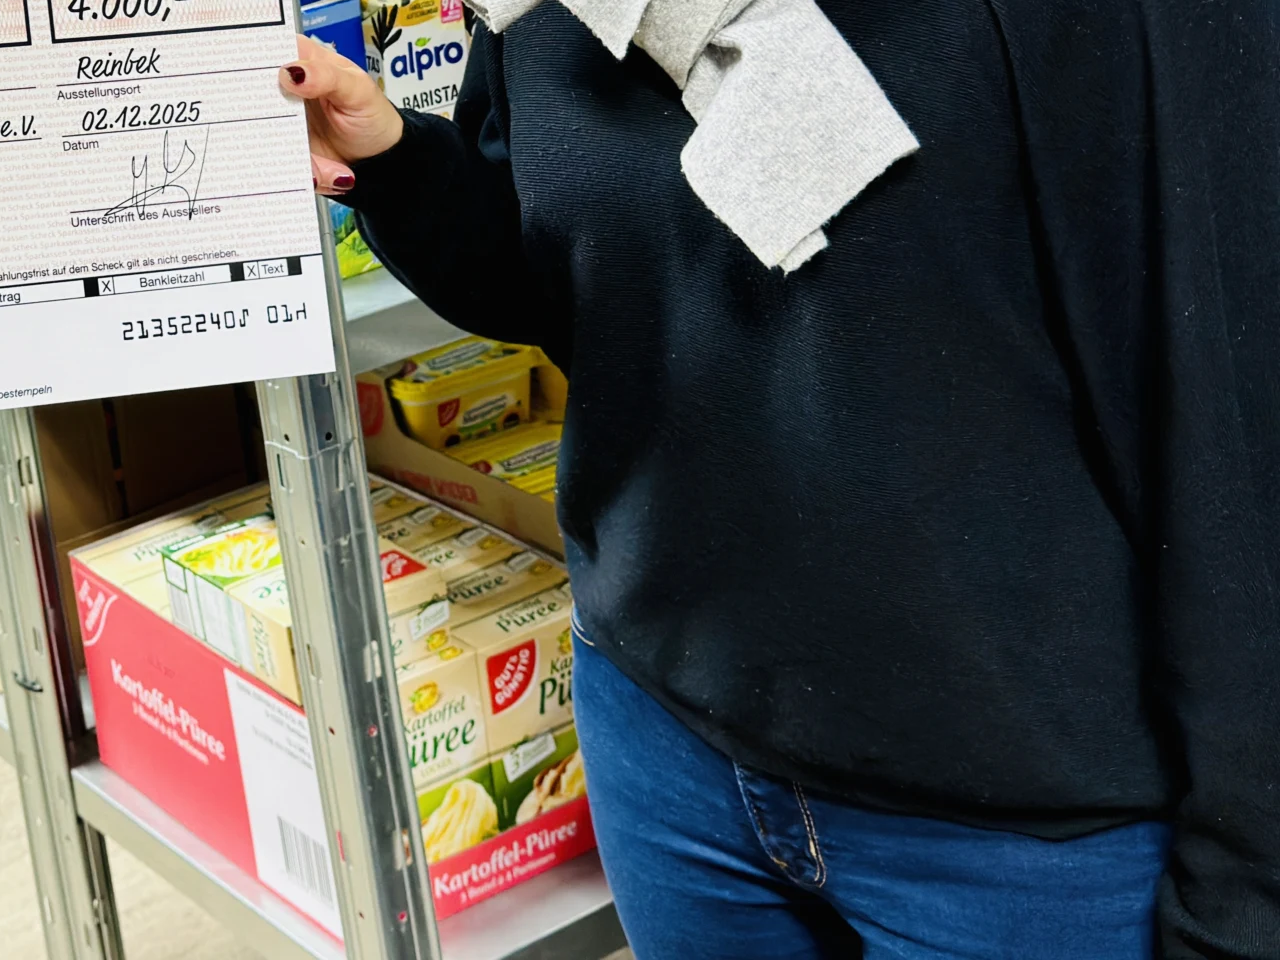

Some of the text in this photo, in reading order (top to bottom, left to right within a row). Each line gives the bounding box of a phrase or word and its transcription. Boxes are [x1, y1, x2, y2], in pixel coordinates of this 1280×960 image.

[77, 48, 161, 79] Reinbek
[390, 40, 464, 80] alpro
[57, 85, 141, 100] Ausstellungsort
[402, 85, 459, 109] BARISTA
[82, 101, 202, 131] 02.12.2025
[63, 140, 99, 151] Datum
[71, 204, 221, 227] Unterschrift des Ausstellers
[52, 264, 67, 276] auf
[69, 263, 89, 274] dem
[91, 259, 124, 273] Scheck
[126, 256, 141, 271] gilt
[142, 256, 155, 267] als
[157, 254, 179, 265] nicht
[181, 250, 240, 265] geschrieben.
[101, 280, 112, 292] X
[140, 269, 206, 289] Bankleitzahl
[246, 263, 257, 277] X
[261, 261, 284, 276] Text
[494, 655, 518, 688] GUT&
[494, 648, 530, 705] GÜNSTIG
[110, 658, 226, 761] Kartoffel-Püree
[409, 718, 477, 768] üree
[434, 820, 577, 899] Kartoffel-Püree
